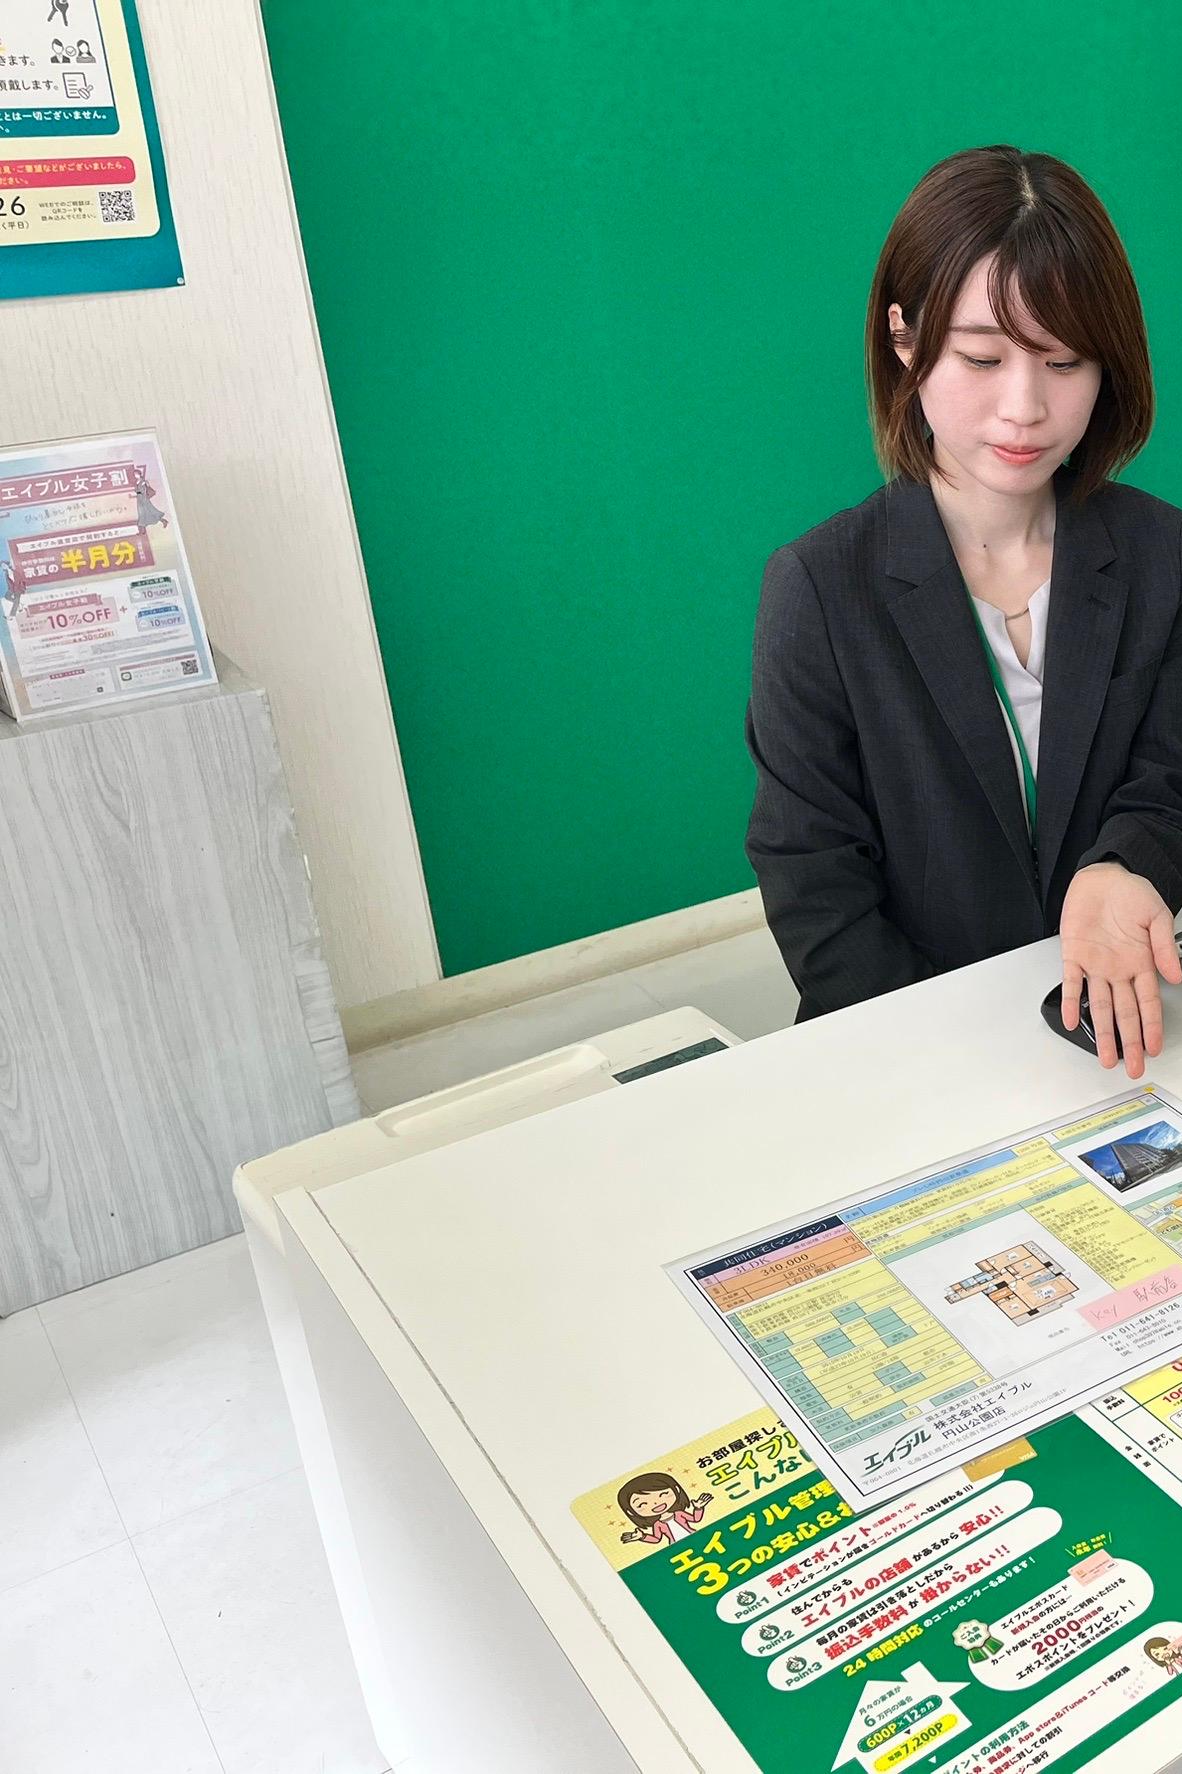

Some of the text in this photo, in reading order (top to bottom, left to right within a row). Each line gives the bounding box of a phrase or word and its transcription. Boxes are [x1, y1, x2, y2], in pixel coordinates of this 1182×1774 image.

[0, 110, 107, 121] とは一切ございません。
[0, 161, 127, 175] 見・ご要望などがございましたら、
[2, 468, 129, 500] エイブル女子割
[61, 541, 136, 573] 半月分
[47, 607, 112, 630] 10%OFF
[760, 1253, 810, 1276] 340,000
[1100, 1331, 1118, 1342] Tel
[931, 1379, 1034, 1431] 株式会社エイブル
[940, 1405, 1007, 1440] 円山公園店
[858, 1428, 938, 1474] エイブル
[1151, 1436, 1175, 1452] ポイント
[667, 1477, 836, 1575] エイブル管理
[766, 1524, 873, 1589] 家賃でポイント
[756, 1504, 1004, 1654] Point2 エイブルの店舗 があるから 安心!!
[790, 1576, 853, 1616] 住んでからも
[734, 1595, 770, 1619] Point1
[785, 1543, 1011, 1686] Point3 振込手数料 が 掛からない!!
[815, 1561, 954, 1646] 毎月の家賃は引き落としだから
[989, 1576, 1127, 1665] カードが届いたその日からご利用いただける
[999, 1583, 1069, 1629] エイブルエポスカード
[959, 1626, 980, 1640] ご入会
[1014, 1599, 1135, 1680] エポスポイントをプレゼント!
[857, 1685, 902, 1715] 月々の家賃が
[861, 1694, 914, 1728] 6万円の場合
[1014, 1750, 1050, 1774] ジへ移行
